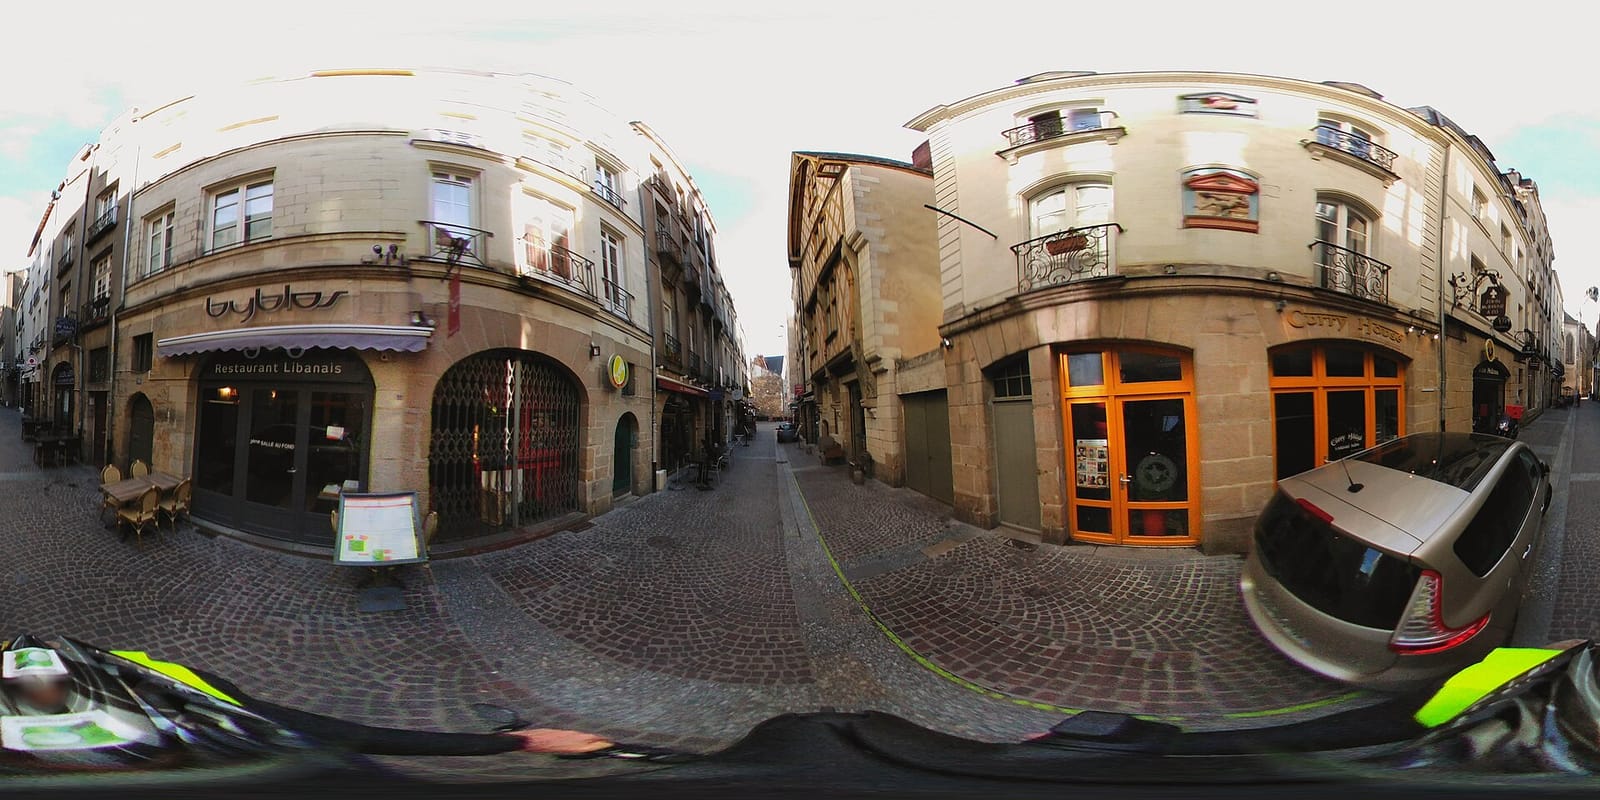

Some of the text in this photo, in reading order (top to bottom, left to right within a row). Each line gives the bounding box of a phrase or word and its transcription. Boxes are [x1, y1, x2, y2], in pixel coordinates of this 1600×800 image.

[206, 284, 349, 324] byblos
[1287, 310, 1348, 331] Curry
[215, 362, 342, 374] Restaurant Libanais
